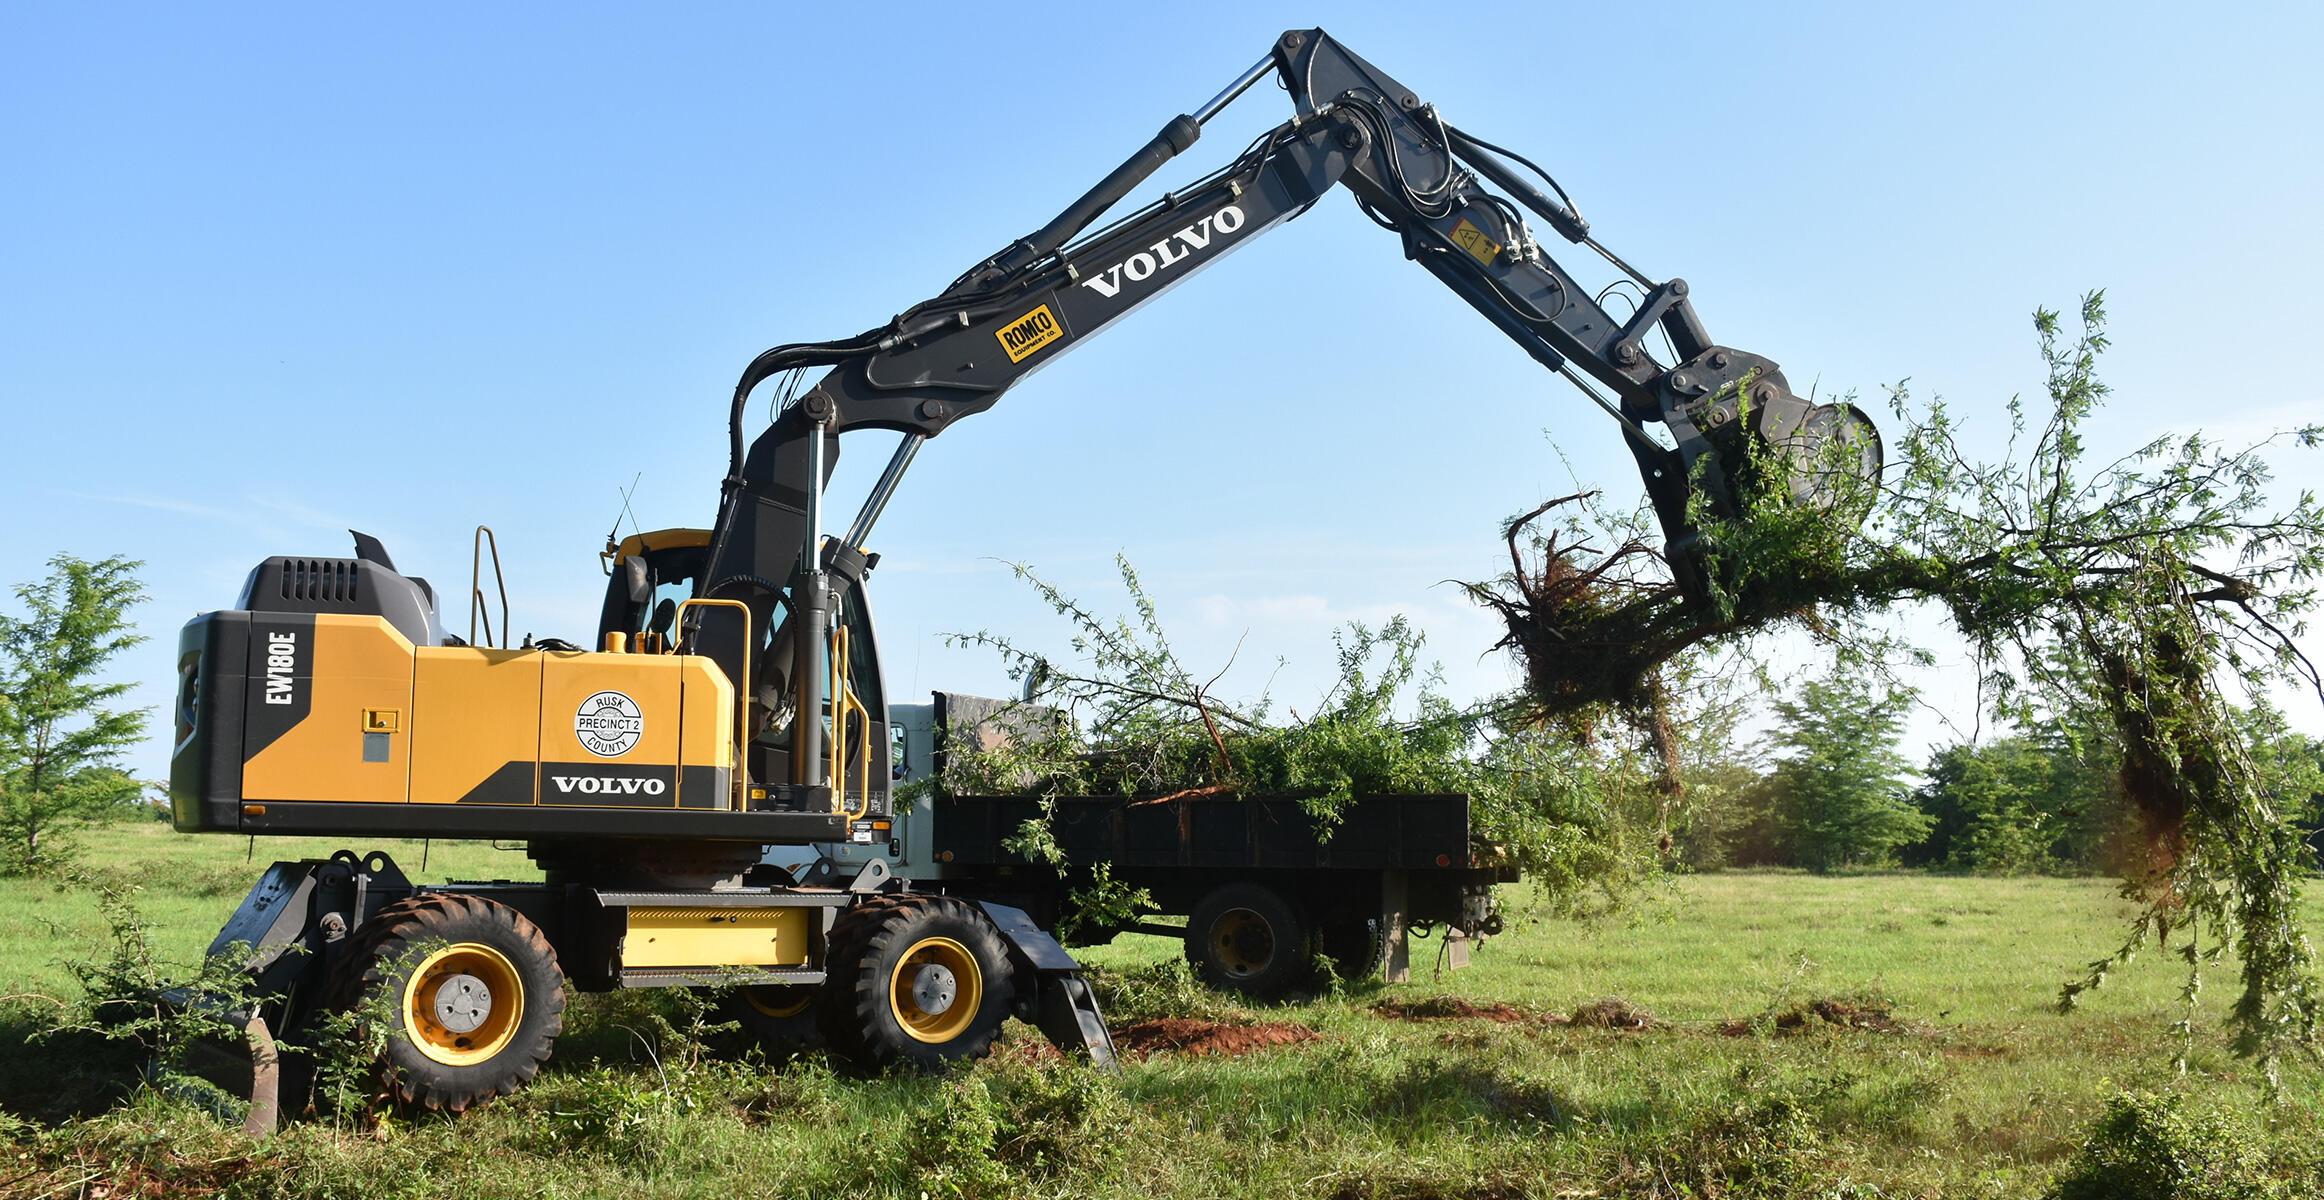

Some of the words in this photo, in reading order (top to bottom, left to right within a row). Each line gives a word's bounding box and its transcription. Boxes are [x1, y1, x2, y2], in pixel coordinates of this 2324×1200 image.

[1081, 205, 1245, 298] VOLVO
[1002, 312, 1052, 350] ROMCO
[1014, 335, 1046, 357] EQUIPMENT
[265, 632, 296, 705] EW180E
[595, 696, 625, 708] RUSK
[579, 718, 631, 730] PRECINCT
[633, 720, 640, 730] 2
[587, 737, 627, 753] COUNTY
[551, 776, 666, 795] VOLVO
